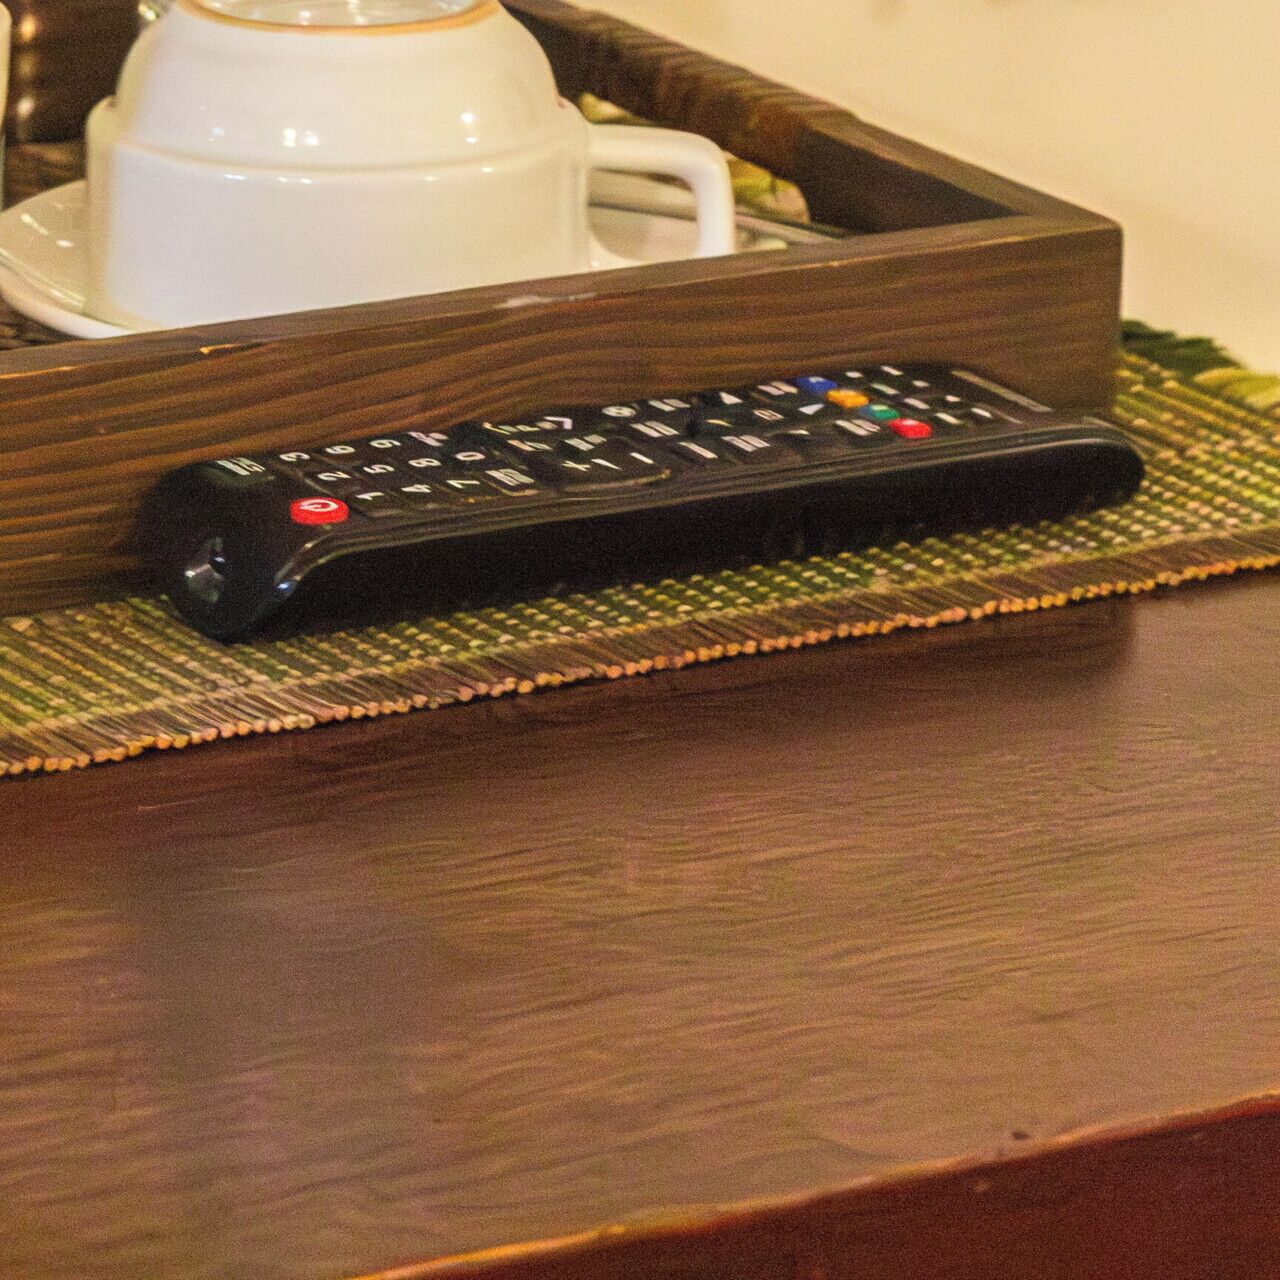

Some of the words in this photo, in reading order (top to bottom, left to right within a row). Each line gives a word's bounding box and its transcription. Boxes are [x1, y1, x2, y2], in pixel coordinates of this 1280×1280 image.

[370, 439, 401, 449] 9
[325, 445, 356, 455] 6
[279, 451, 310, 462] 3
[454, 451, 486, 462] 0
[408, 457, 440, 468] 8
[363, 464, 395, 474] 5
[317, 471, 352, 482] 2
[401, 484, 432, 493] 4
[446, 479, 480, 489] 7
[355, 491, 385, 501] 1
